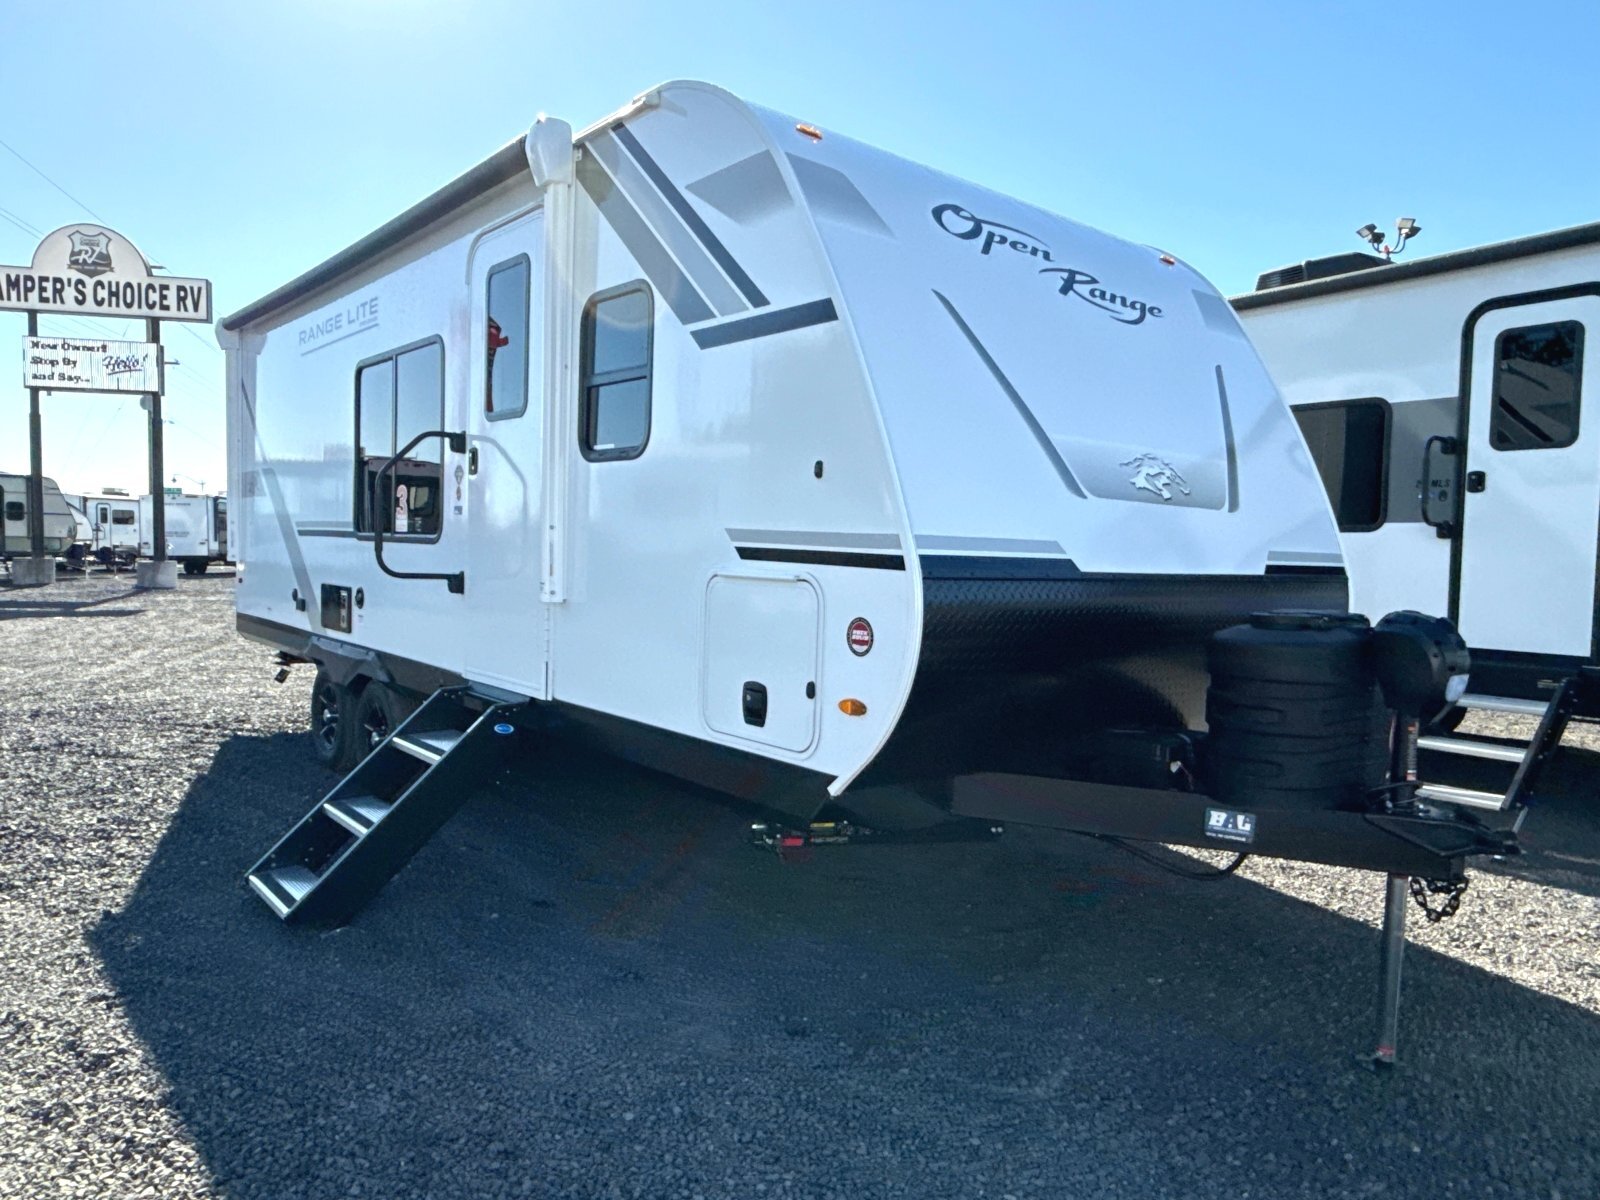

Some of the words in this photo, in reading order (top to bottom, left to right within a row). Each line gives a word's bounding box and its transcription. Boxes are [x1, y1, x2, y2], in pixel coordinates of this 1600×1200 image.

[931, 203, 1054, 262] Open
[93, 279, 170, 311] CHOICE
[176, 285, 202, 313] RV
[299, 312, 343, 346] RANGE
[347, 297, 378, 325] LITE
[1039, 268, 1164, 325] Range
